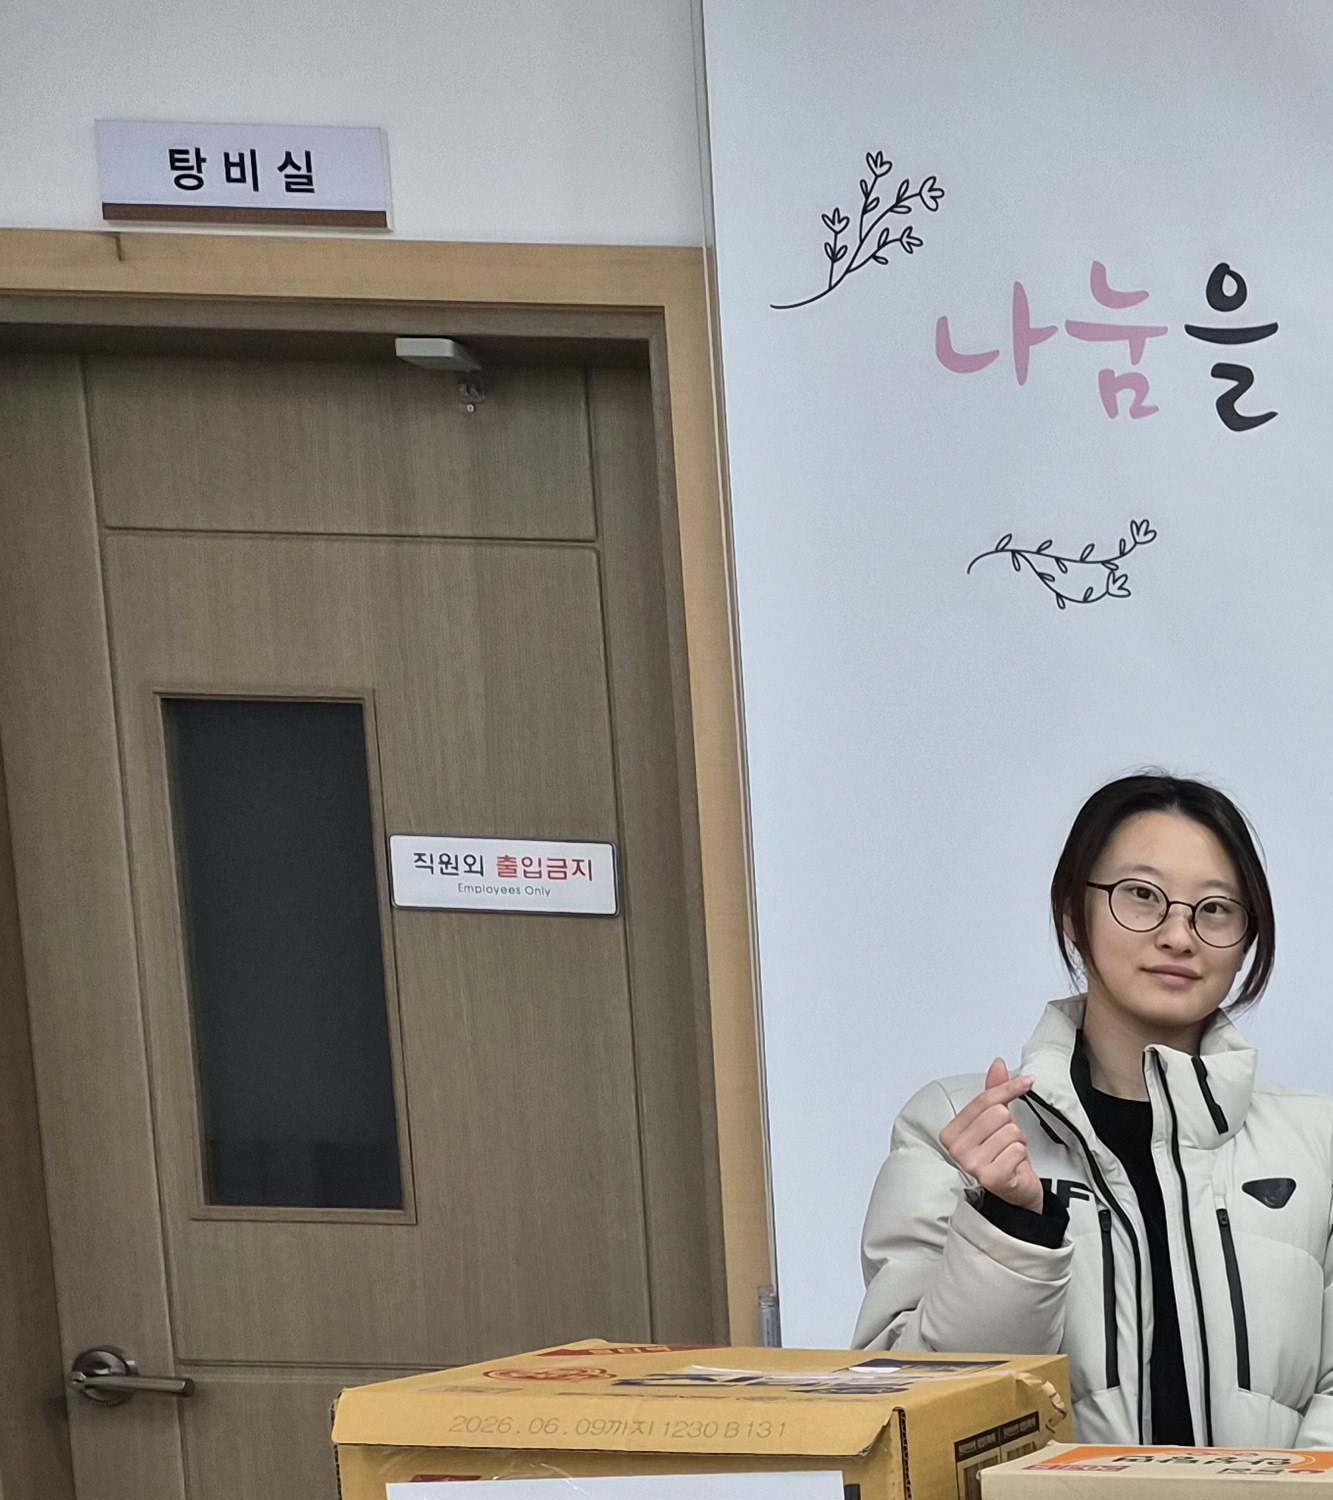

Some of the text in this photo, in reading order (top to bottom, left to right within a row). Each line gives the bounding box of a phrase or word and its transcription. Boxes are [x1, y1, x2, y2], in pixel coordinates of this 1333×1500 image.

[169, 147, 315, 193] 탕비실
[935, 260, 1279, 431] 나눔을
[414, 853, 592, 881] 직원외 출입금지
[458, 883, 550, 897] Employees Only
